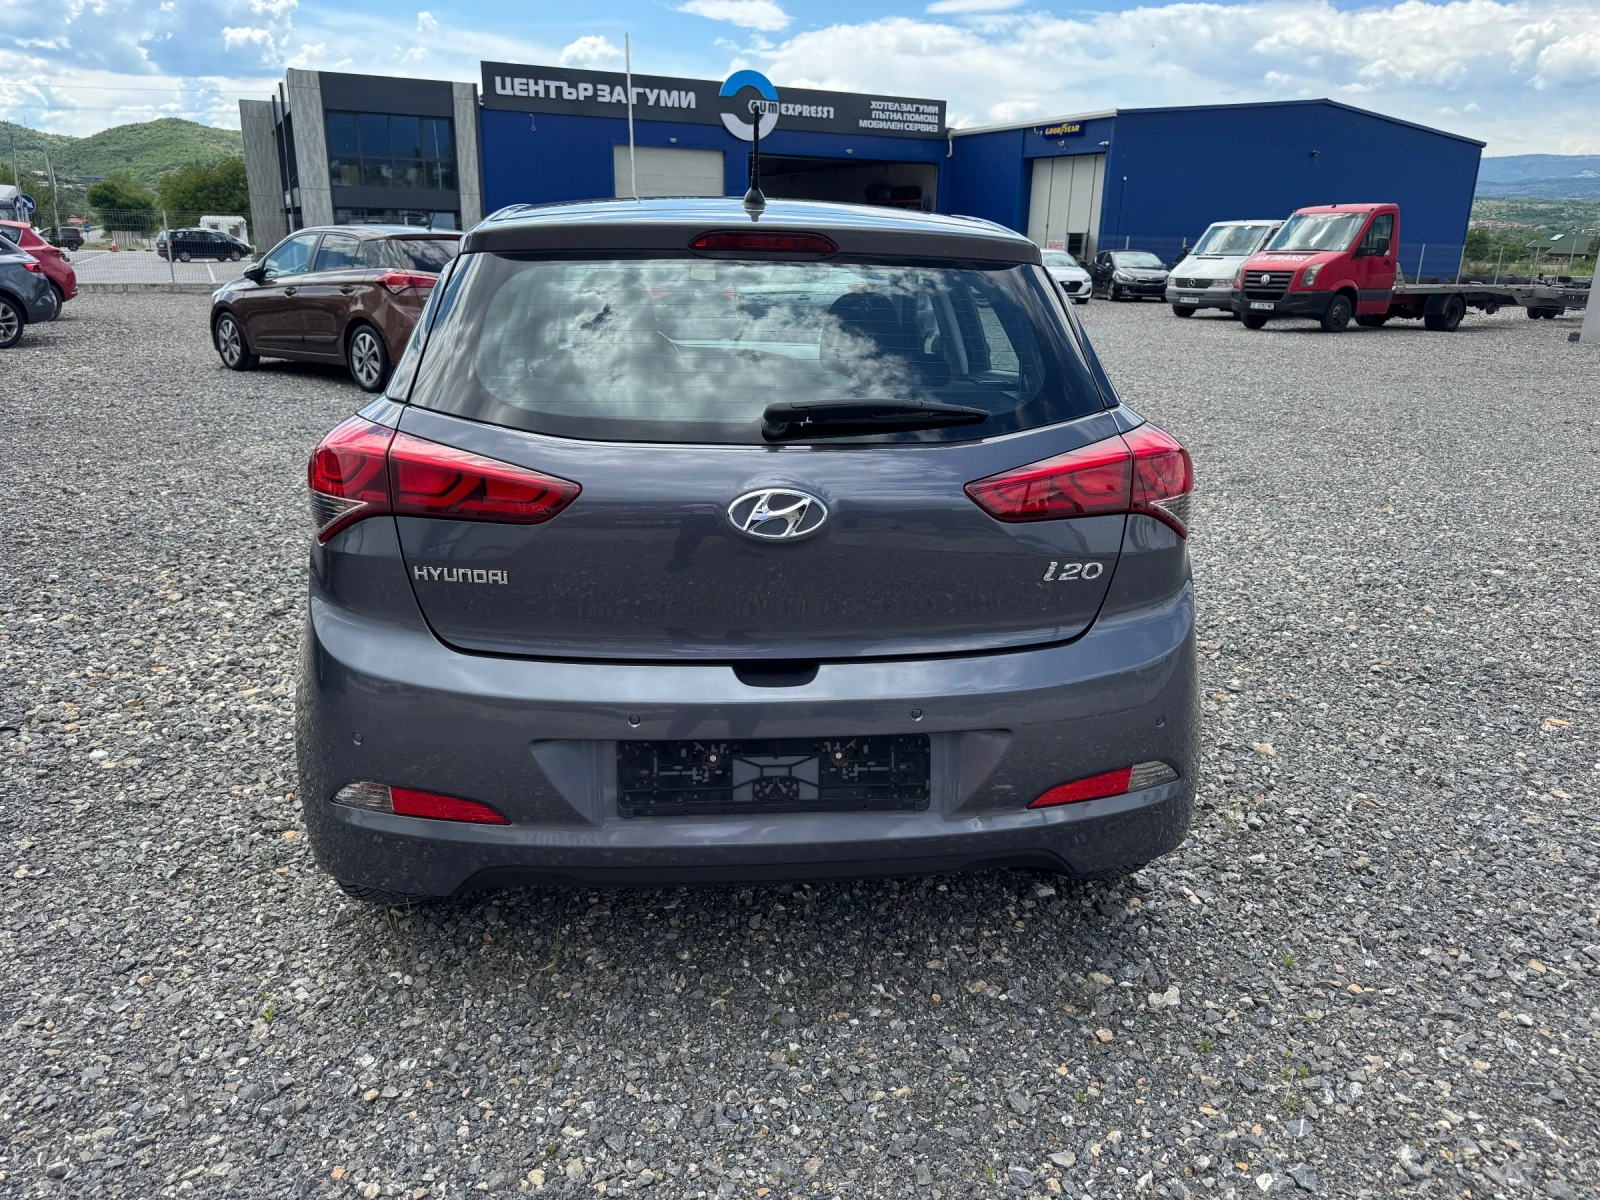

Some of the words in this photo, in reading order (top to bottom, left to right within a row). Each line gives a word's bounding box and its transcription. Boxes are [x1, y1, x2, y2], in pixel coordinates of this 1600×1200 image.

[494, 75, 594, 101] ЦЕНТЪР
[596, 84, 628, 105] ЗА
[630, 87, 697, 110] ГУМИ
[870, 100, 900, 111] ХОТЕЛ
[899, 103, 913, 112] ЗА
[912, 104, 939, 114] ГУМИ
[871, 110, 903, 121] ПЪТНА
[903, 113, 939, 123] ПОМОЩ
[859, 119, 903, 131] МОБИЛЕН
[904, 122, 938, 133] СЕРВИЗ
[1045, 123, 1080, 136] GOODYEAR
[413, 565, 509, 585] HYUNDAI
[1042, 561, 1104, 582] i20
